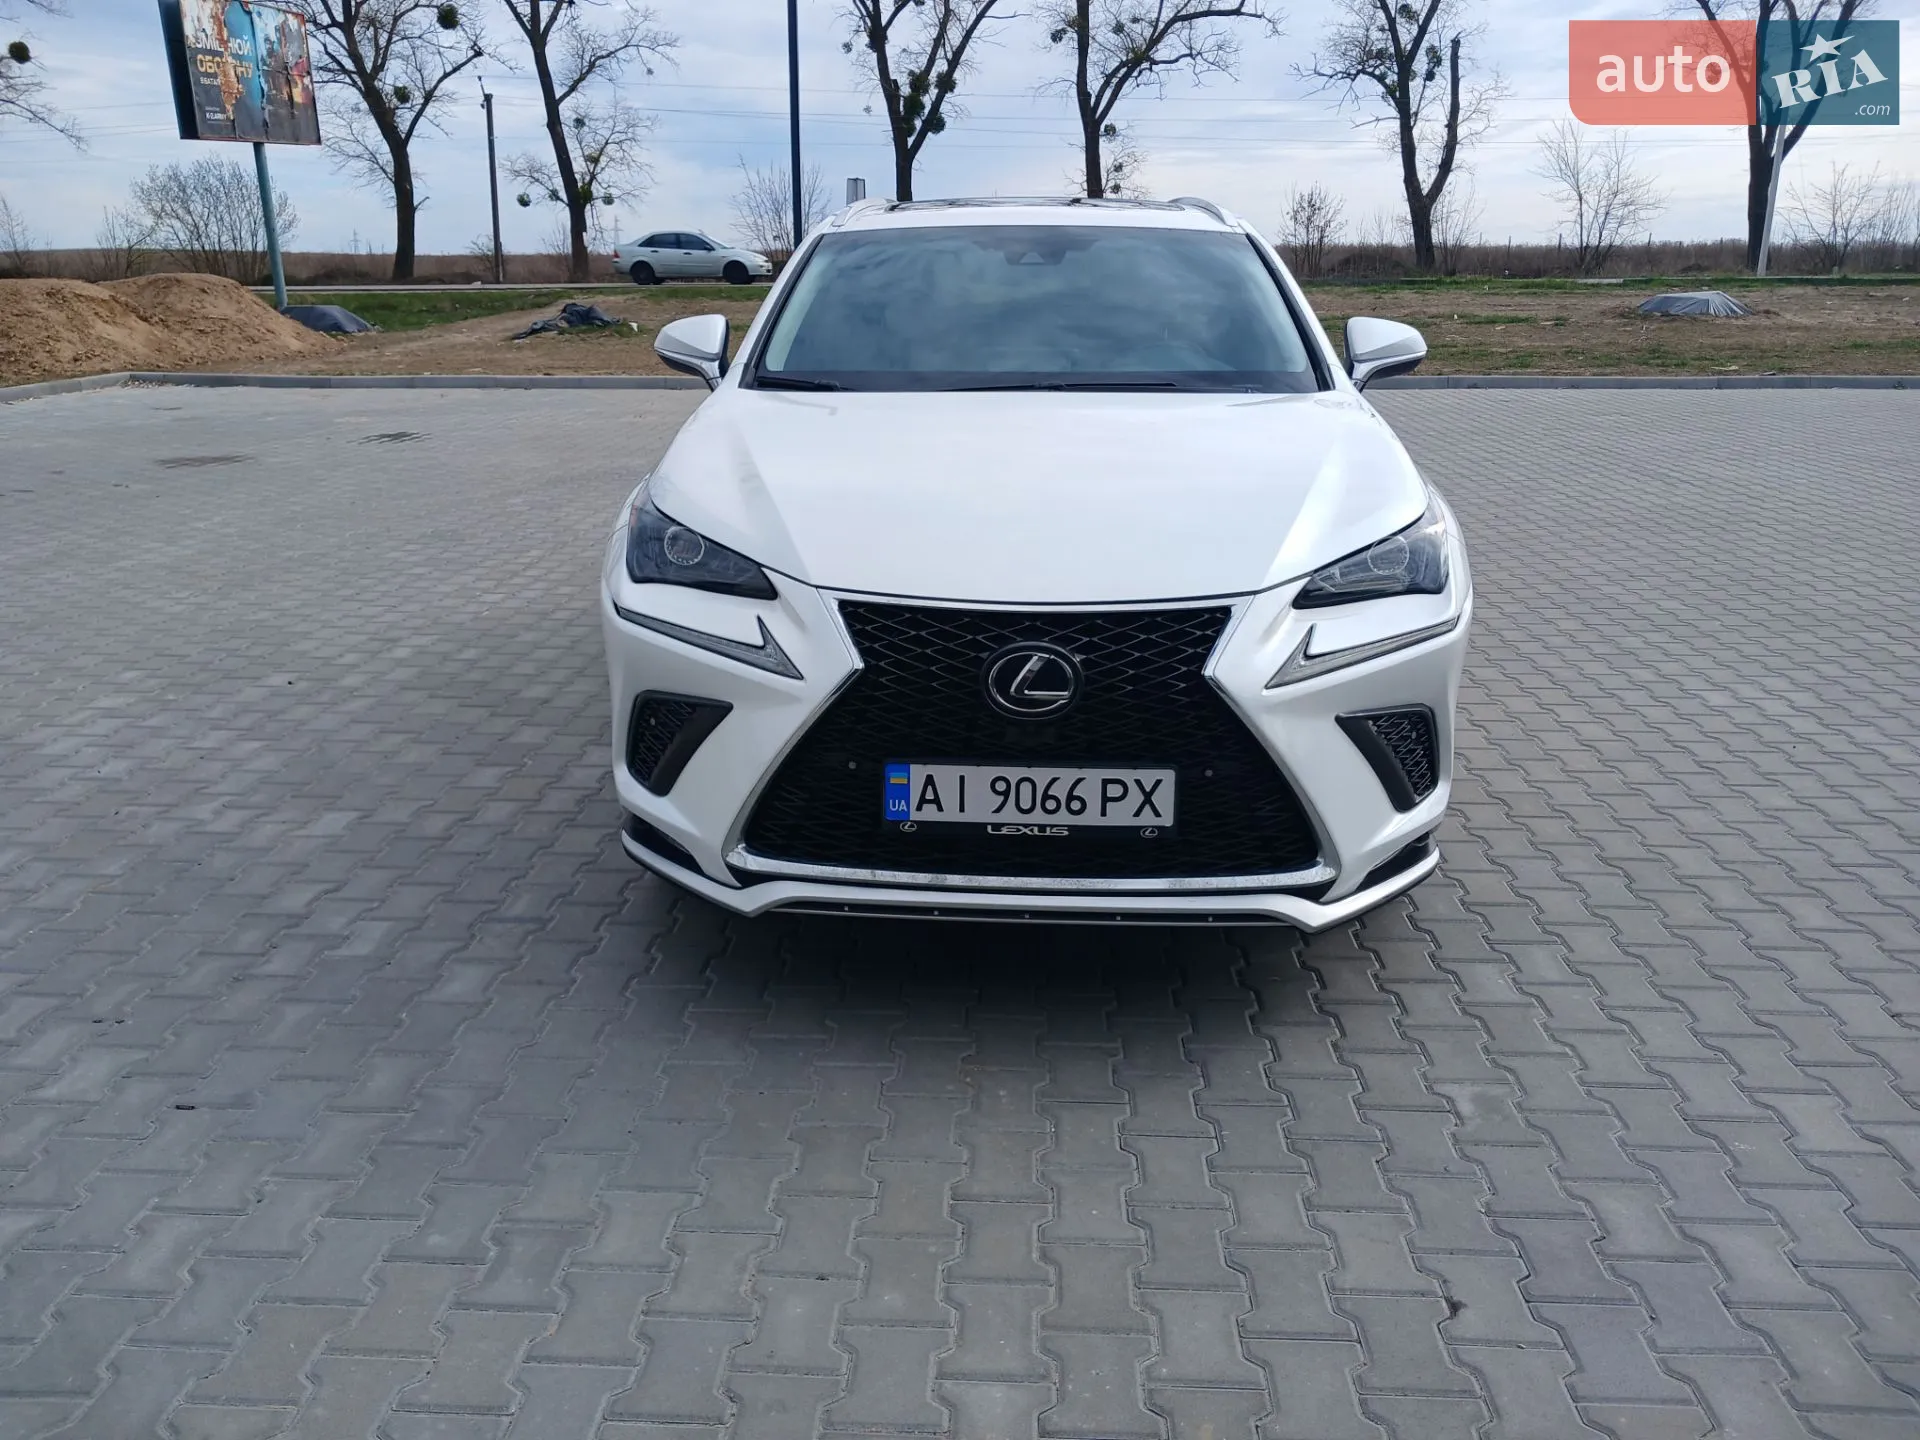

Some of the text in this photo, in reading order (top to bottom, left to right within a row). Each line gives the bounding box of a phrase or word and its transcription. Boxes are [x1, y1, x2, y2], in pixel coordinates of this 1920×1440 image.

[915, 773, 1164, 818] AI 9066 PX
[889, 799, 908, 812] UA
[987, 825, 1070, 836] LEXUS
